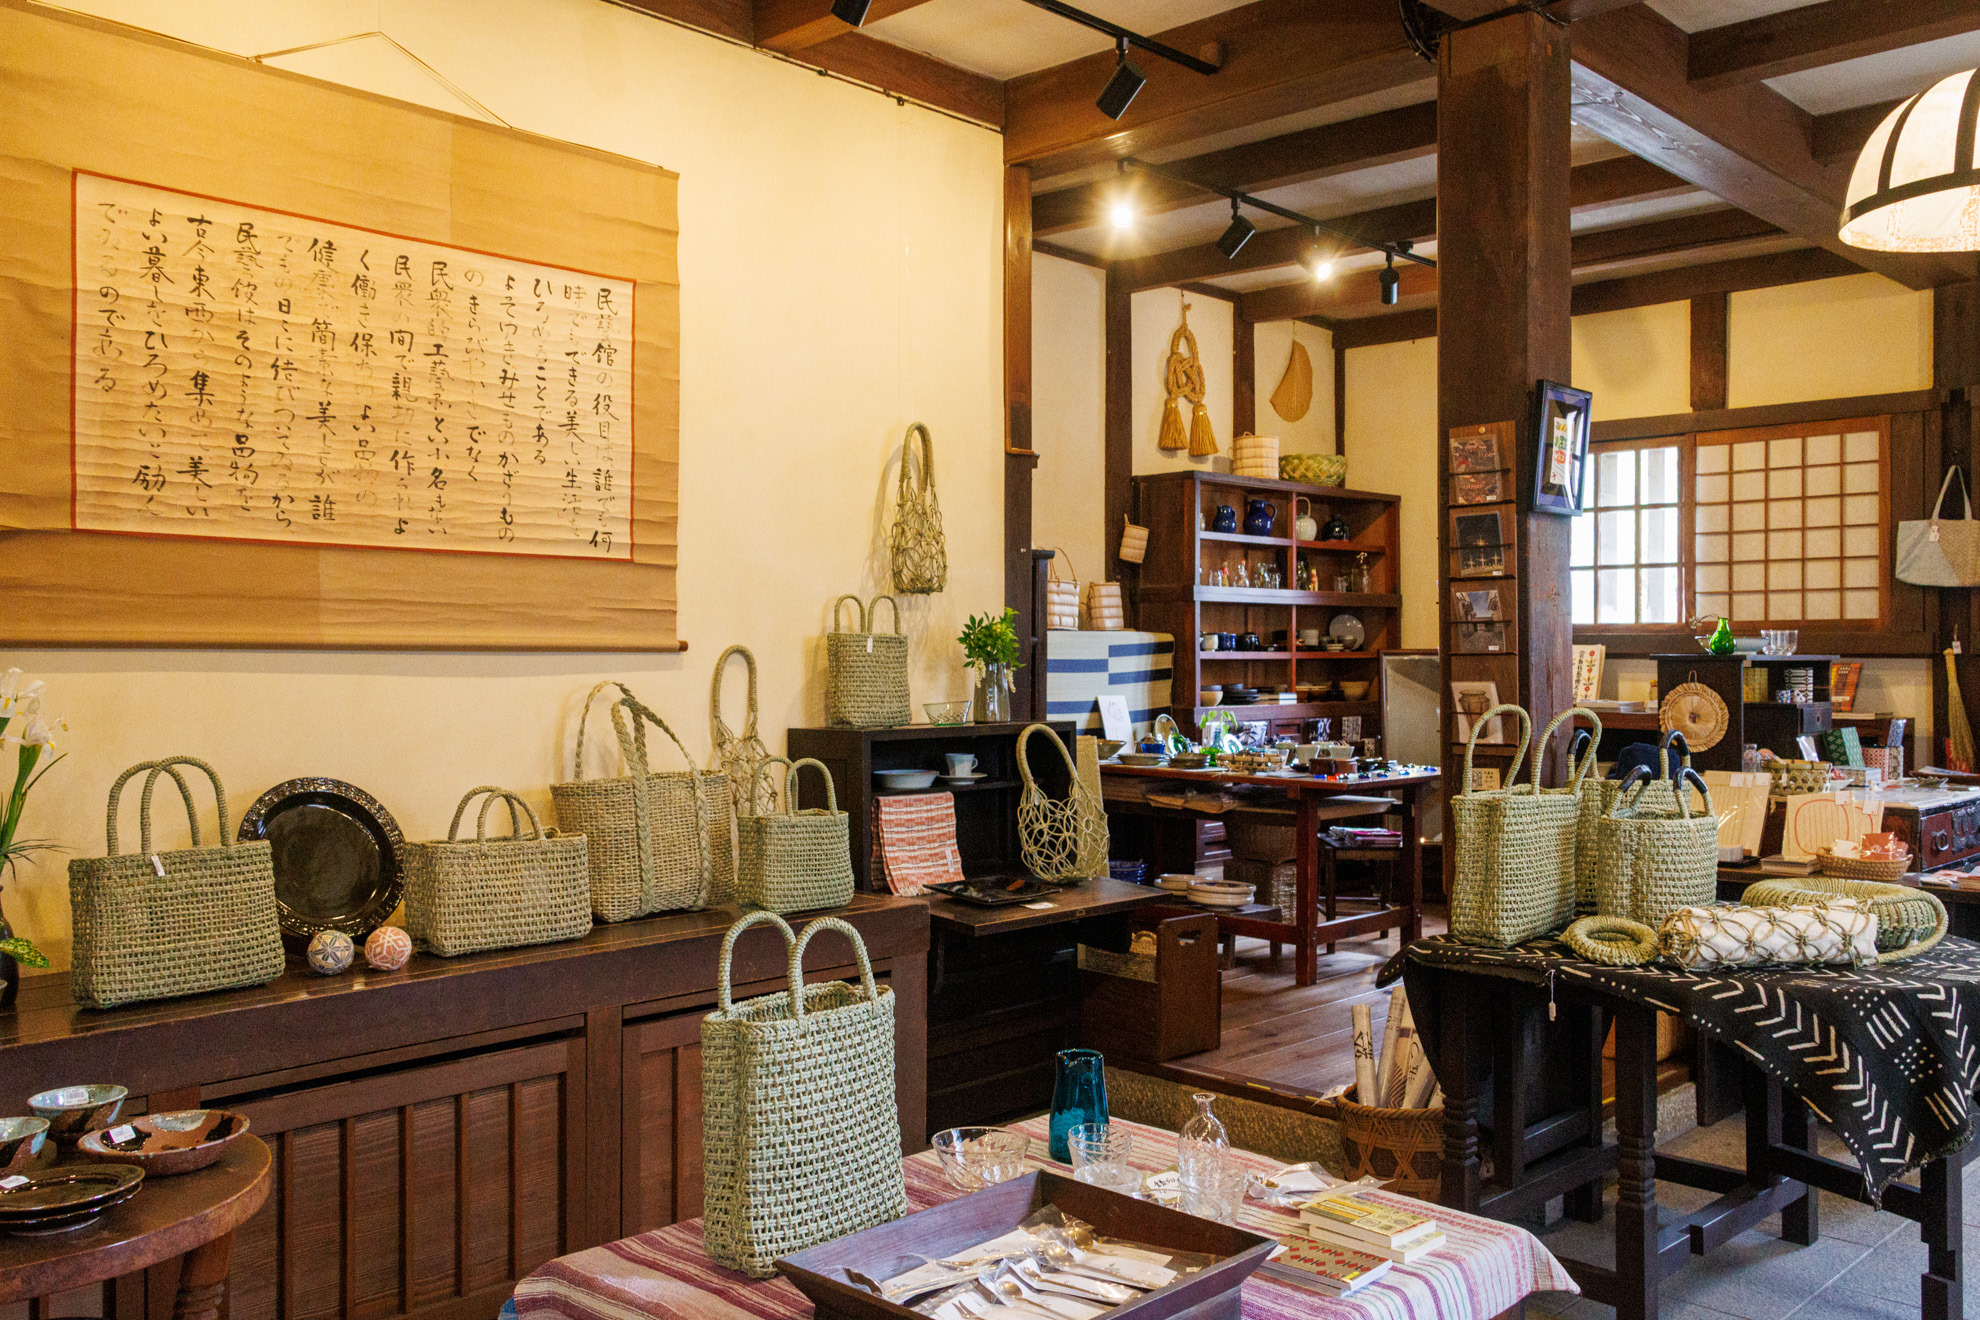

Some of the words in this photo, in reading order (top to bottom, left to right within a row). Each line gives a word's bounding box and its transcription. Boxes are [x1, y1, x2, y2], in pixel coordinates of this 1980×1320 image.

[532, 278, 552, 465] ひろめることである
